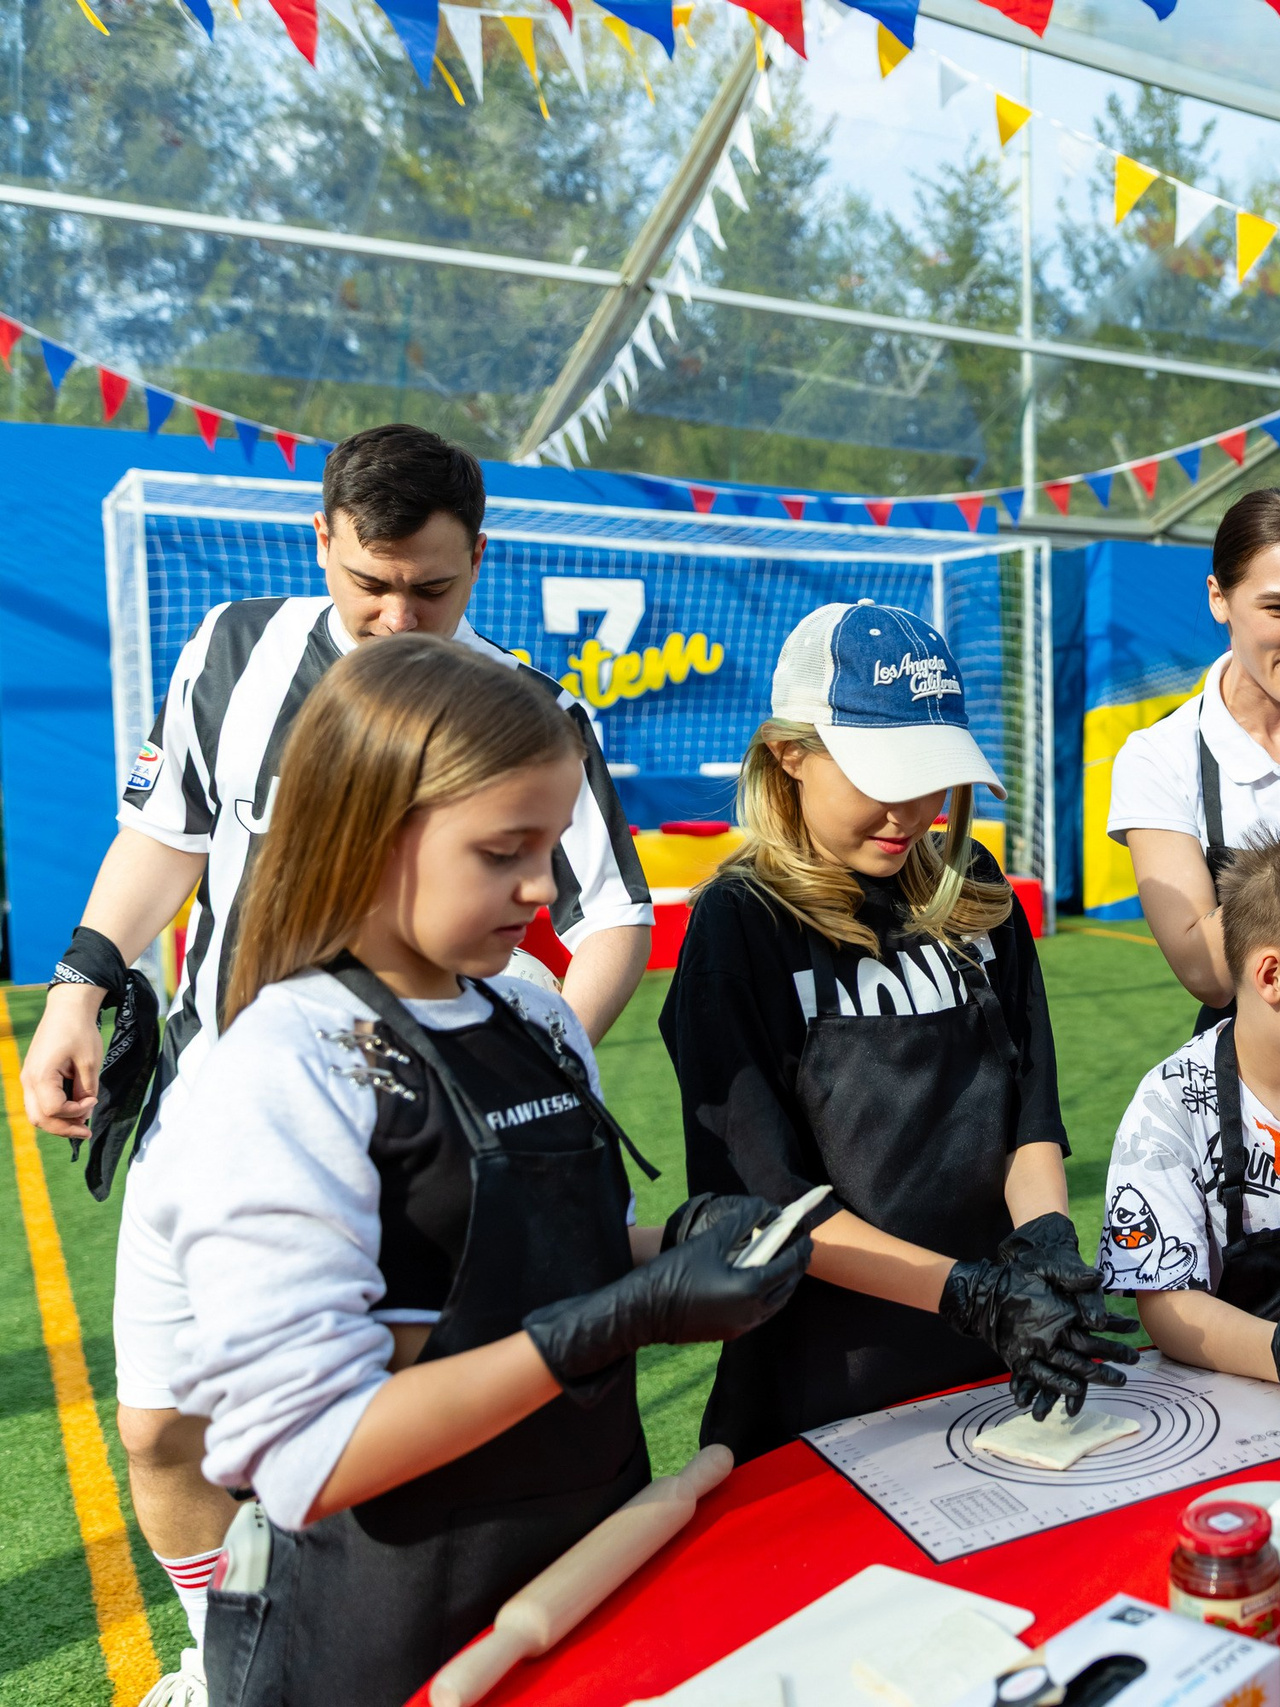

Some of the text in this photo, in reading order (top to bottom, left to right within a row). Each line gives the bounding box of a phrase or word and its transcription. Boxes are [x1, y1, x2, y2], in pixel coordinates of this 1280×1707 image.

[511, 632, 724, 709] tem
[541, 576, 646, 721] 7
[873, 659, 898, 686] Los
[910, 670, 961, 699] Californi
